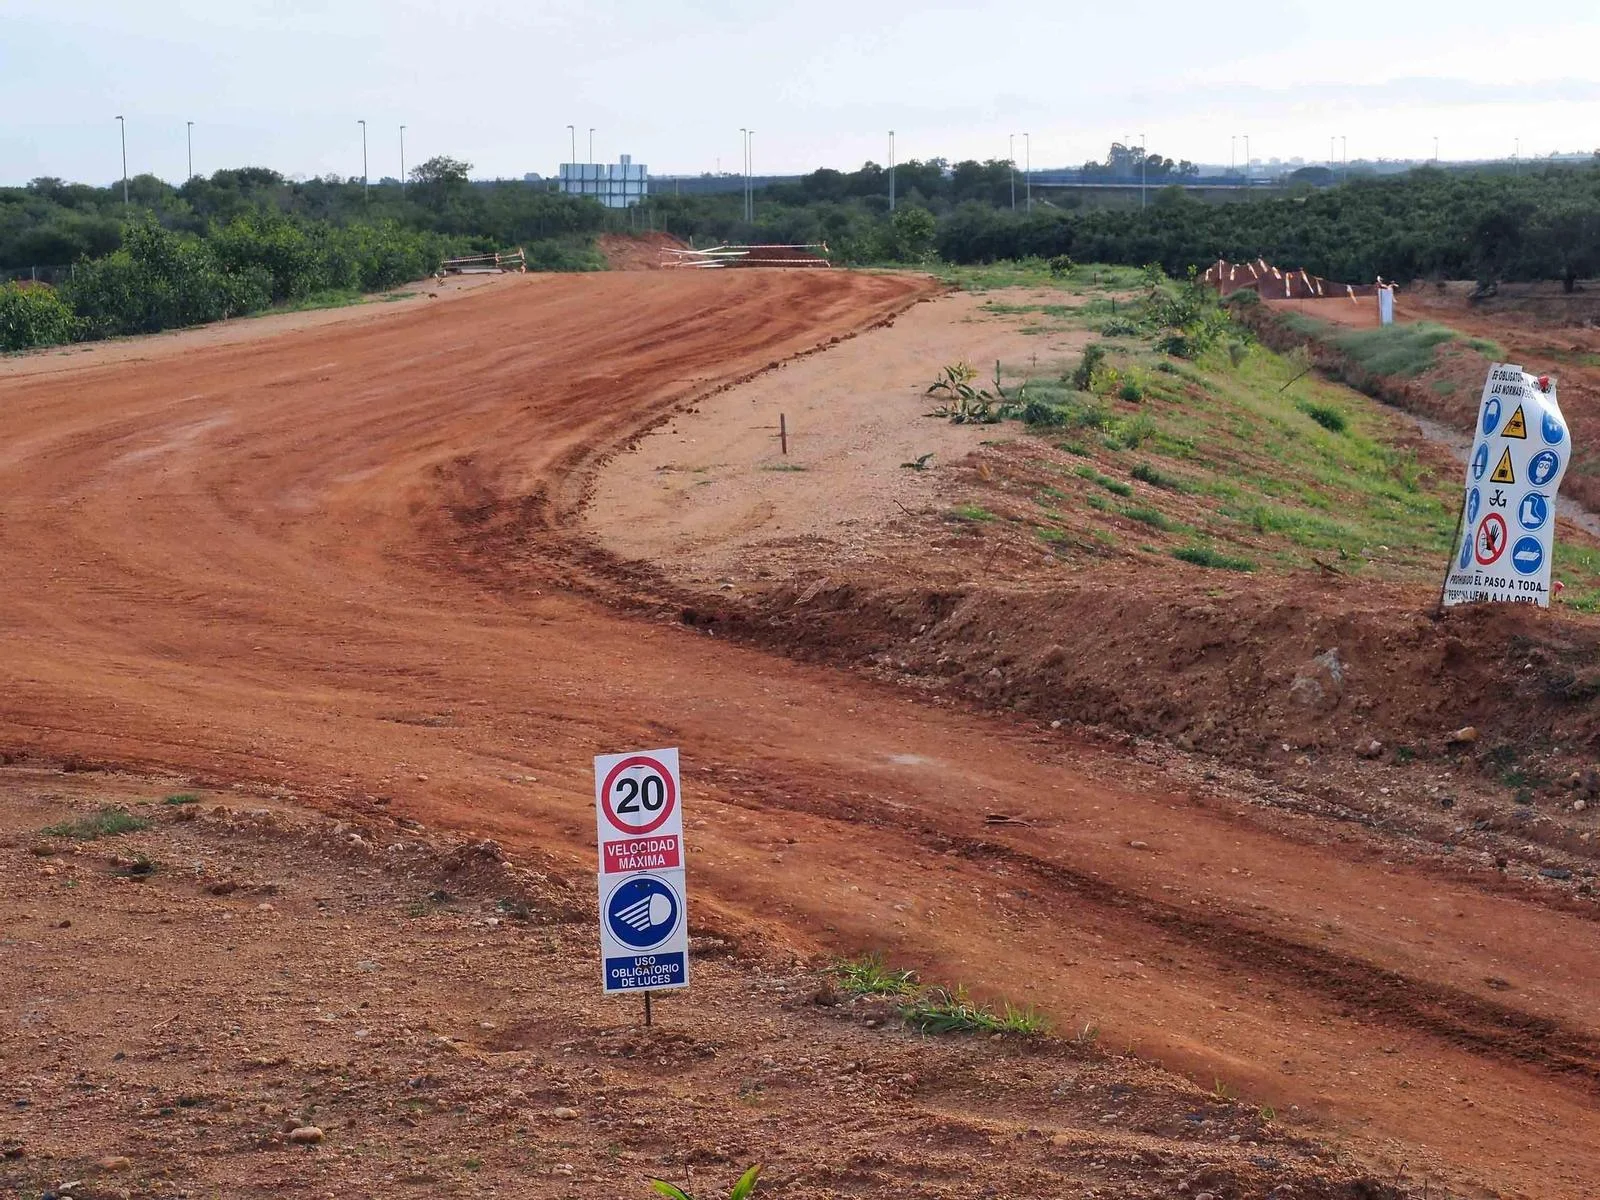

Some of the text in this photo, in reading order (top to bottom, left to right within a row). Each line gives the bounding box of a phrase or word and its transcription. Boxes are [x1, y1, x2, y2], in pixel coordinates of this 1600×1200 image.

[1491, 383, 1502, 394] LAS
[1474, 575, 1482, 586] EL
[1484, 576, 1506, 588] PASO
[1508, 579, 1514, 589] A
[1518, 580, 1542, 592] TODA
[616, 775, 664, 814] 20
[607, 838, 675, 857] VELOCIDAD
[619, 854, 666, 870] MÁXIMA
[634, 956, 656, 967] USO
[611, 963, 680, 979] OBLIGATORIO
[621, 974, 671, 988] DE LUCES
